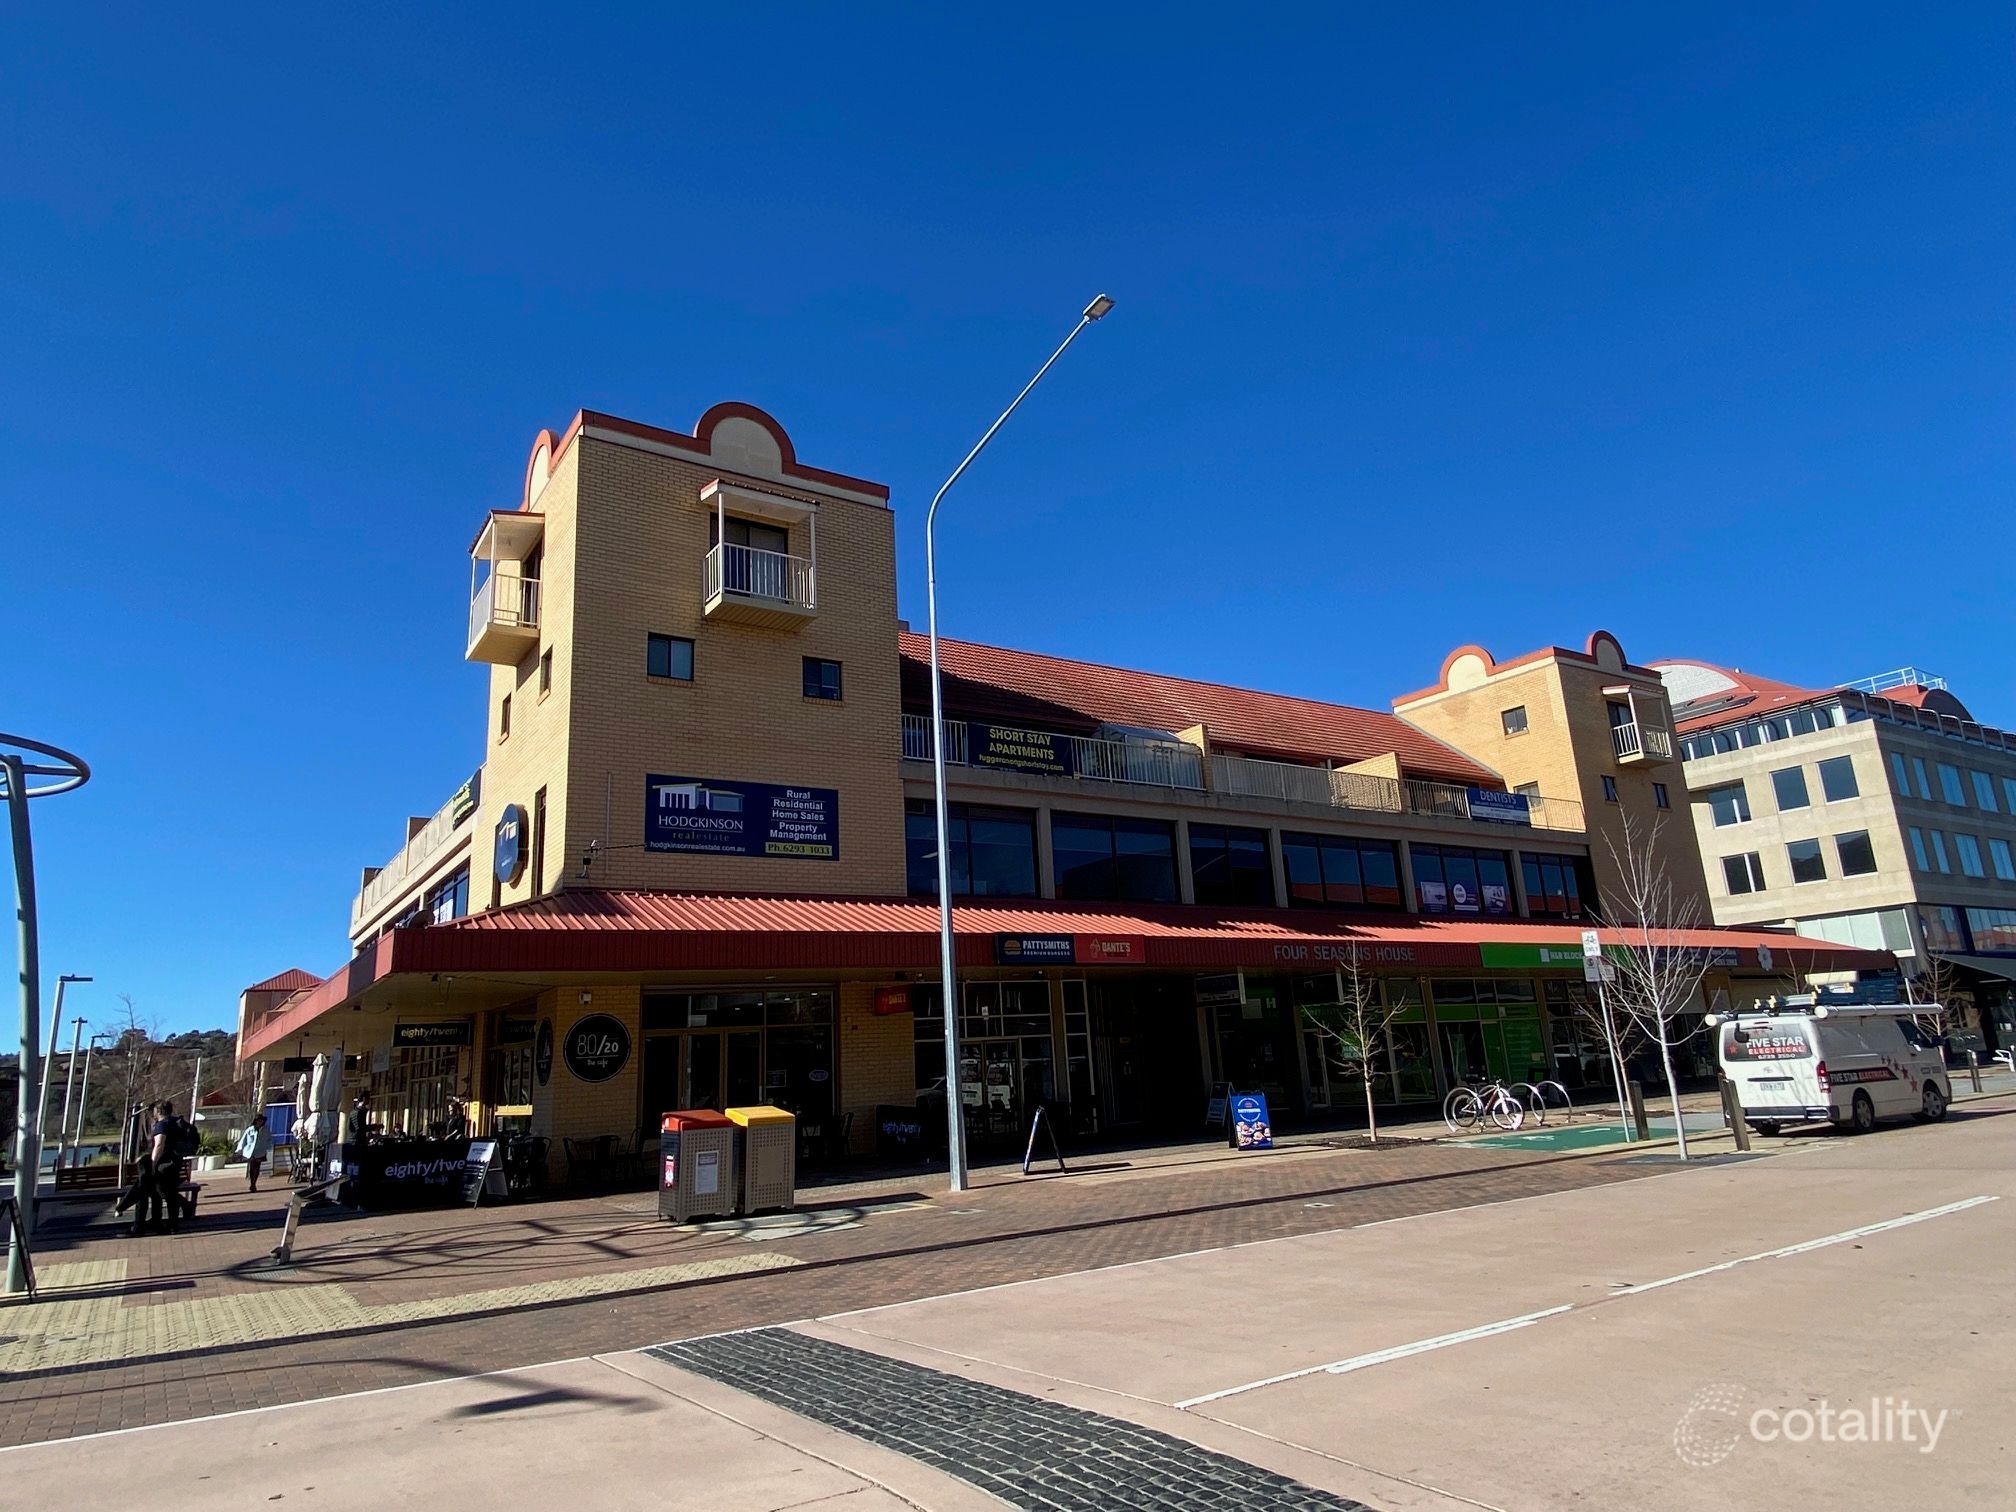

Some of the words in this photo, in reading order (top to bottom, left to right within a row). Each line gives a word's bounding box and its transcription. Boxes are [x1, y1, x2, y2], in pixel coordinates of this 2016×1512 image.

[989, 728, 1025, 742] SHORT
[1026, 733, 1051, 746] STAY
[989, 742, 1055, 760] APARTMENTS
[786, 789, 811, 800] Rural
[1479, 790, 1517, 805] DENTISTS
[773, 799, 823, 810] Residential
[772, 809, 799, 820] Home
[800, 811, 825, 821] Sales
[658, 814, 744, 830] HODGKINSON
[779, 822, 818, 833] Property
[769, 829, 827, 841] Management
[650, 841, 746, 853] hodgkinsonrealestate.com.au
[810, 845, 830, 855] 1033
[1022, 939, 1070, 950] PATTYSMITHS
[1101, 942, 1131, 952] DANTE'S
[1273, 945, 1308, 960] FOUR
[1314, 945, 1371, 960] SEASONS
[1376, 946, 1416, 961] HOUSE
[577, 1034, 619, 1056] 80/20
[1746, 1037, 1771, 1048] FIVE
[1772, 1036, 1805, 1047] STAR
[1748, 1046, 1804, 1055] ELECTRICAL
[1830, 1073, 1844, 1083] FIVE
[1843, 1072, 1858, 1082] STAR
[1858, 1070, 1890, 1080] ELECTRICAL
[384, 1159, 466, 1179] eighty/twe
